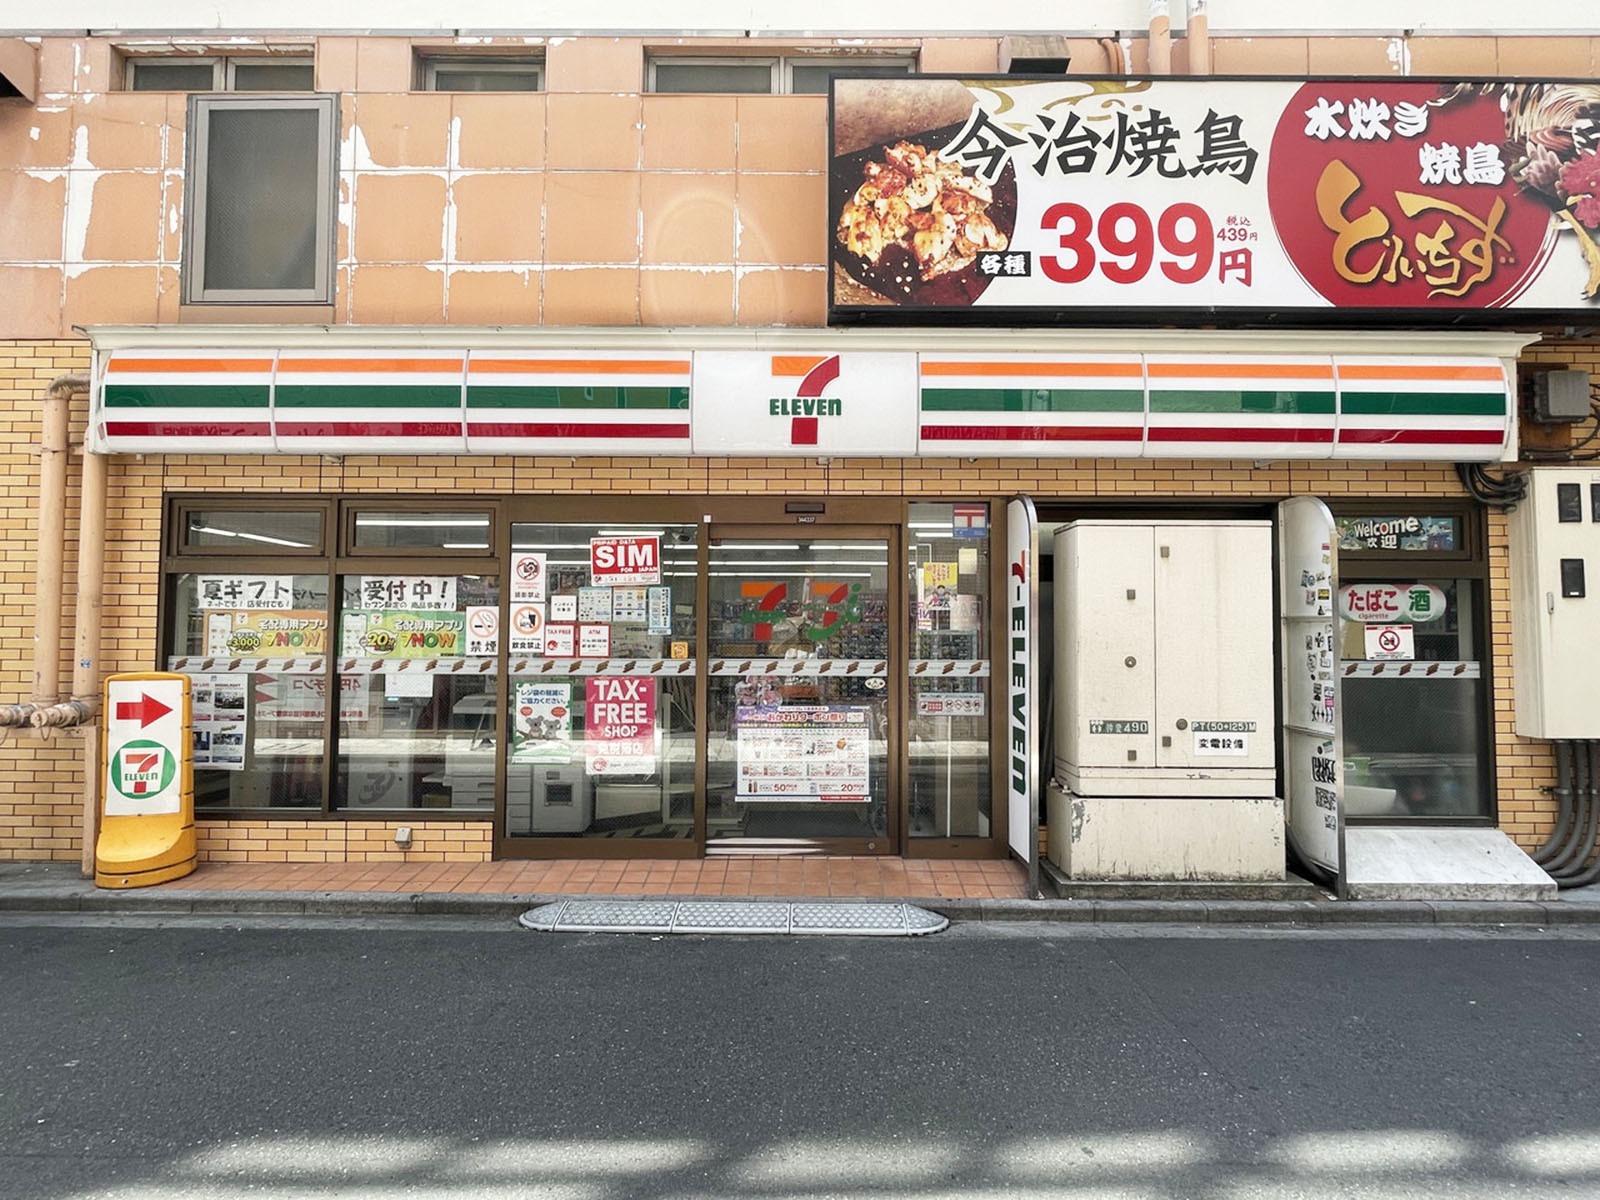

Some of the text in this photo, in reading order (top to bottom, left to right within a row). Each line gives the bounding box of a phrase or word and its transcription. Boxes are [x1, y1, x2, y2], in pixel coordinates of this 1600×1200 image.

[1303, 96, 1428, 141] 水炊き
[944, 107, 1259, 186] 今治焼鳥
[1418, 141, 1506, 186] 焼鳥
[1226, 214, 1251, 227] 税込
[980, 253, 1027, 276] 各種
[1354, 516, 1420, 538] Welcome
[595, 544, 654, 569] SIM
[202, 579, 290, 600] 夏ギフト
[1348, 589, 1431, 612] たばこ 酒
[470, 640, 497, 653] 禁煙
[512, 641, 542, 650] 飲食禁止
[593, 702, 648, 725] FREE
[604, 725, 638, 738] SHOP
[1198, 737, 1244, 749] 変電設備
